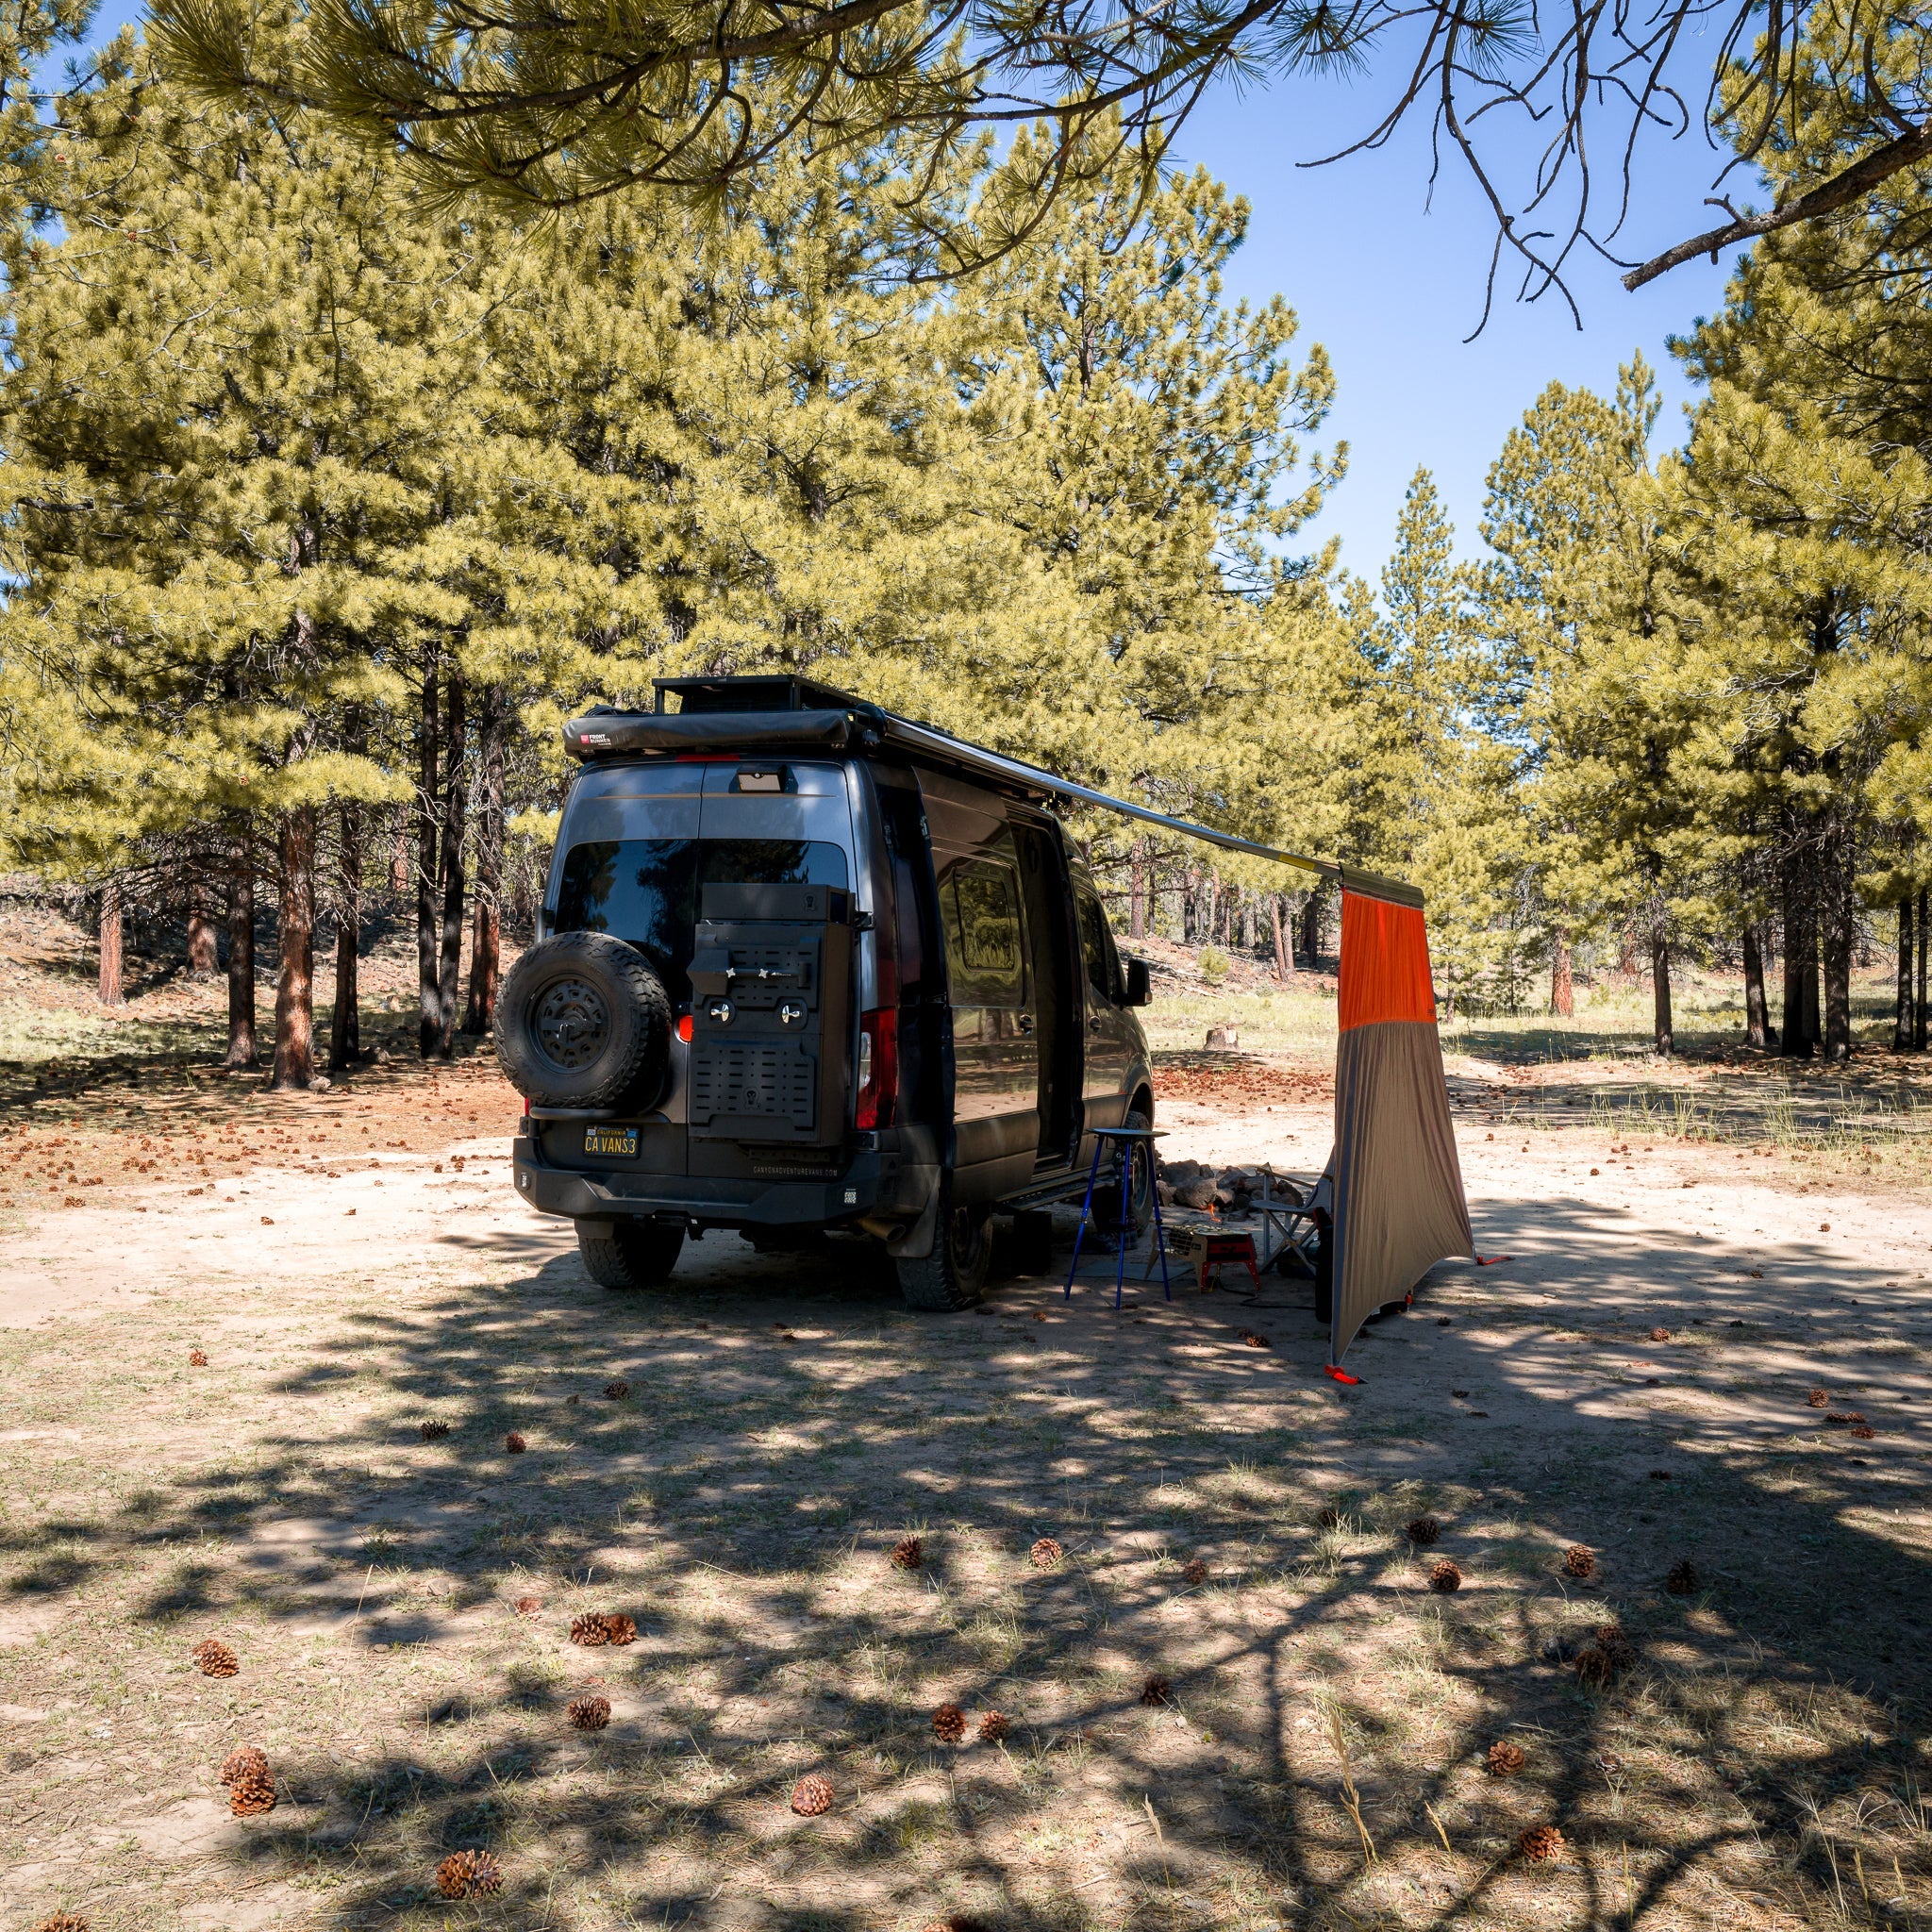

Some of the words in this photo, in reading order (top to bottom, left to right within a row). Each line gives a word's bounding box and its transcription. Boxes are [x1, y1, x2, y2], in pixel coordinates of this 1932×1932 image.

[585, 1136, 599, 1152] CA
[601, 1137, 636, 1154] VANS3
[753, 1166, 838, 1177] CANYONADVENTUREVANS.COM
